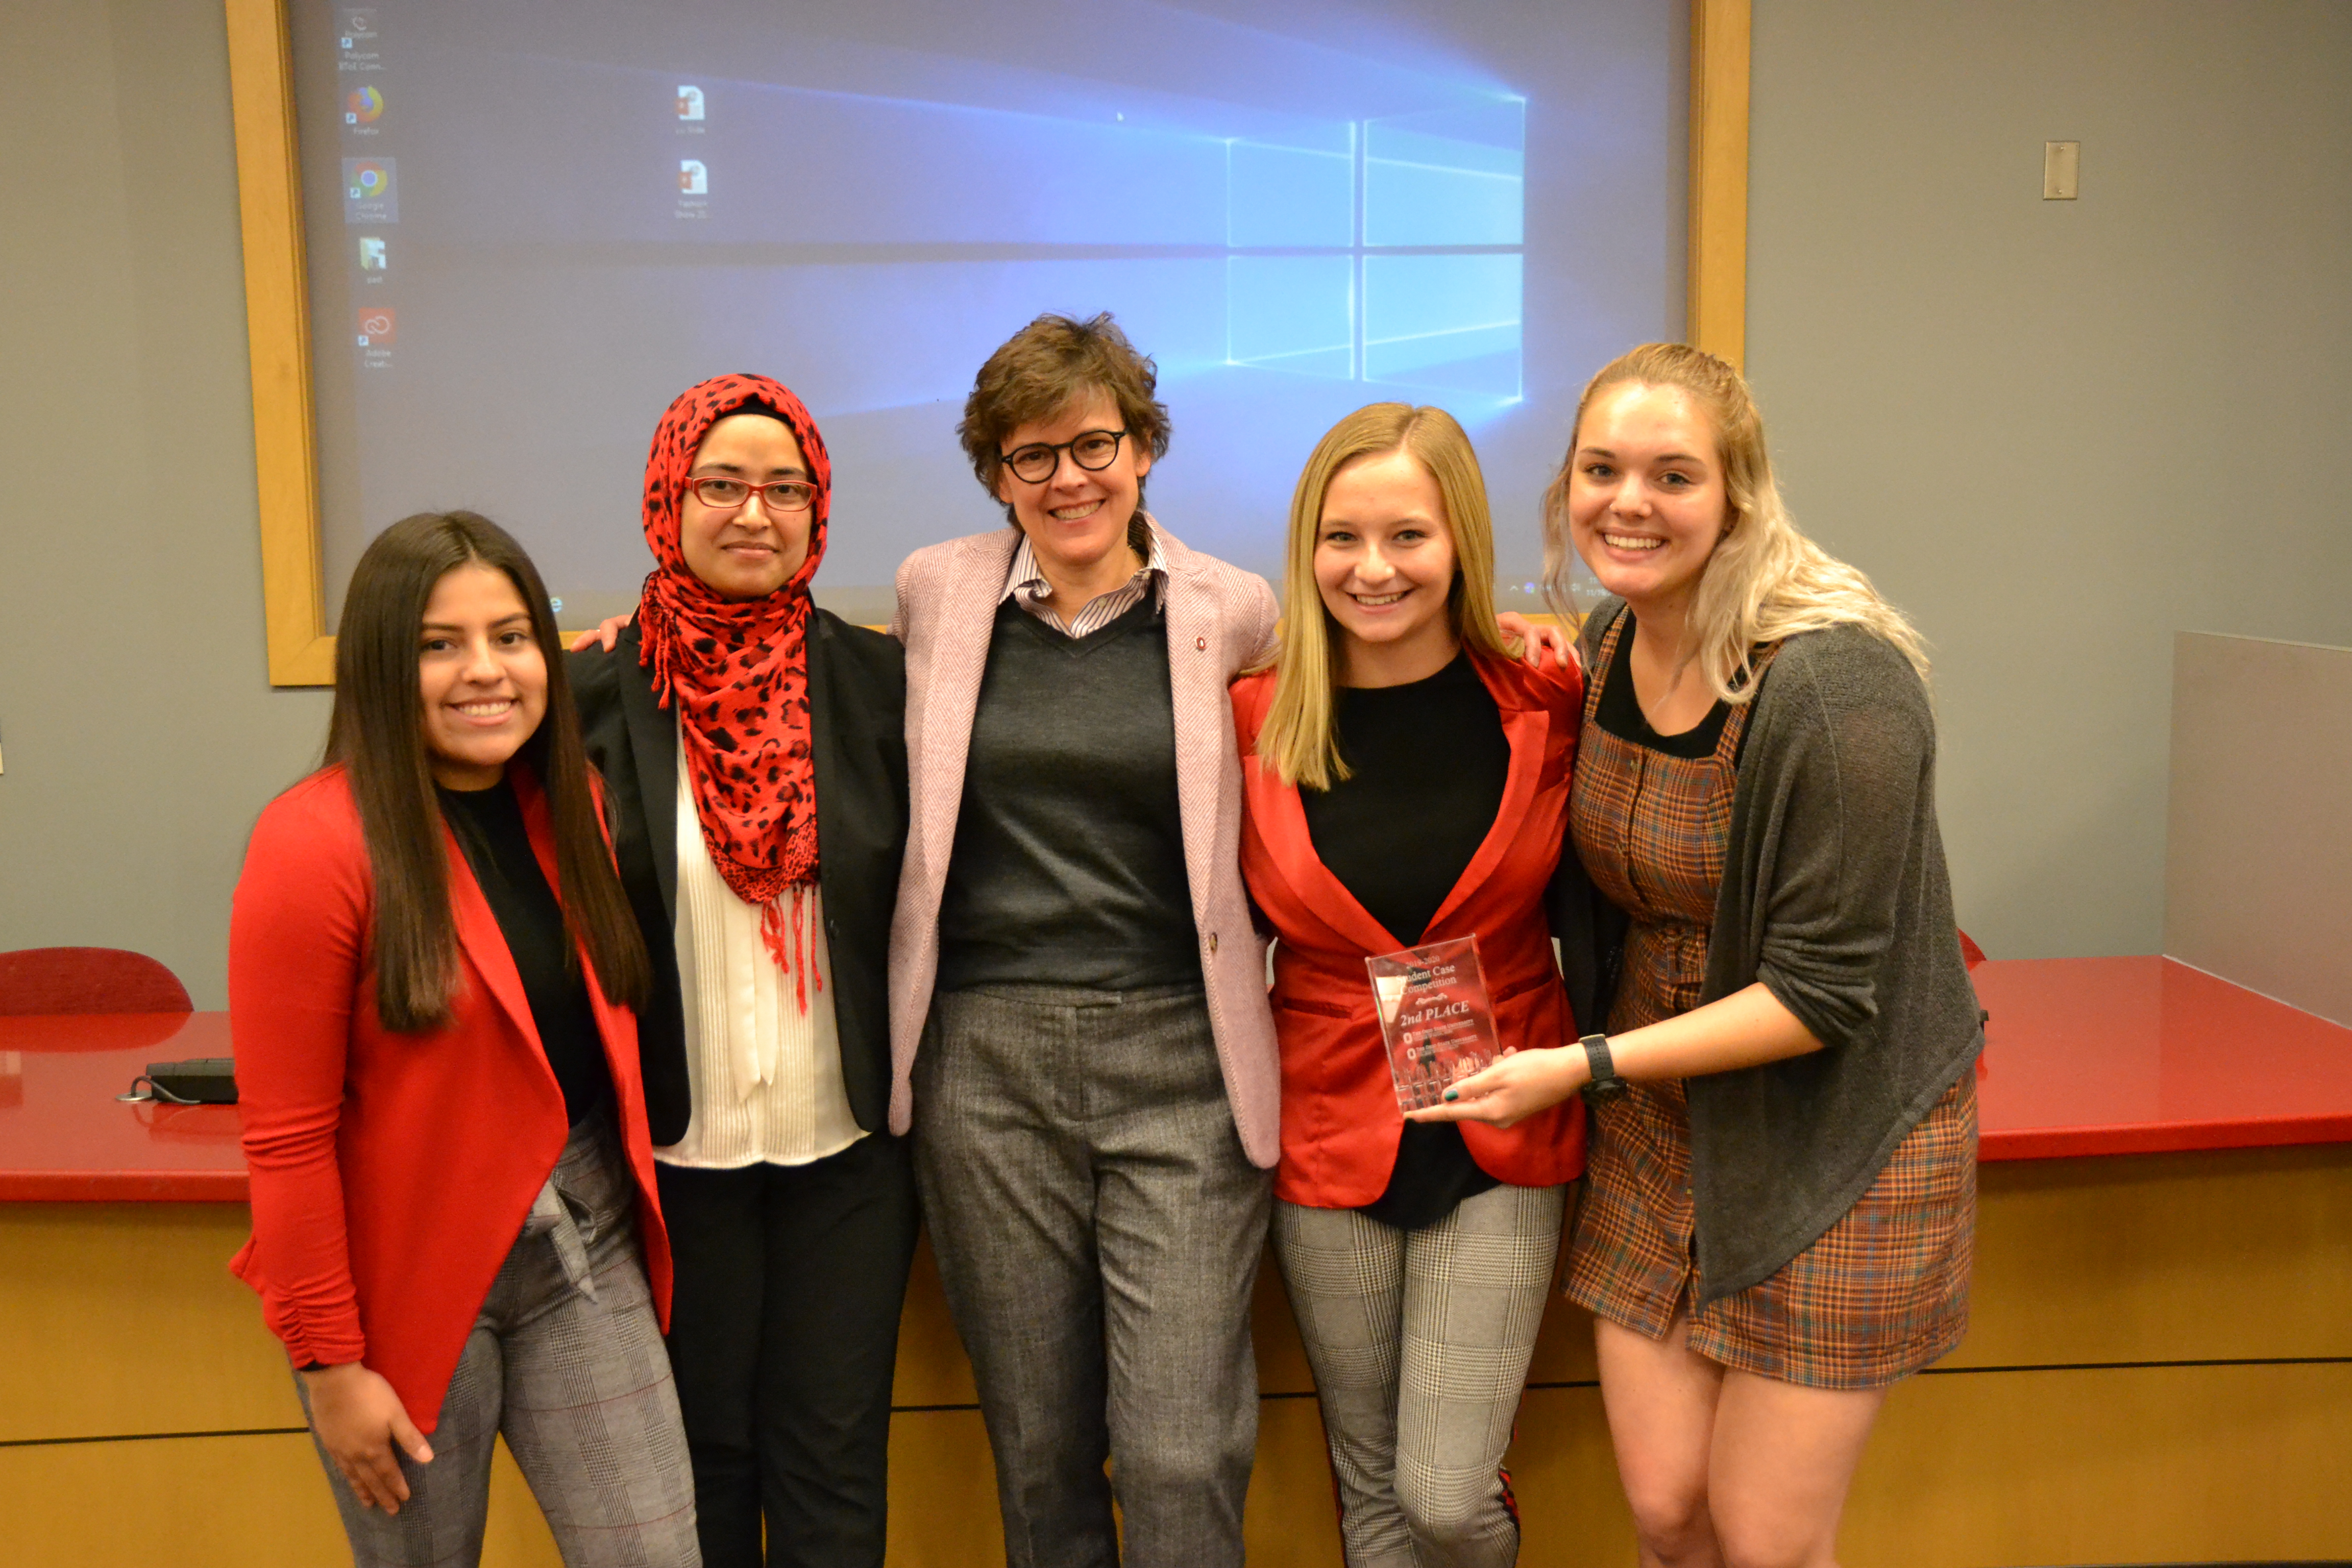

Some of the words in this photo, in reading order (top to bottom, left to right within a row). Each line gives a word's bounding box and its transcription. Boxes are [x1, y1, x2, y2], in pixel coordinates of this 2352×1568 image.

[353, 127, 379, 135] Firefox
[1406, 955, 1440, 967] 2019-2020
[1396, 970, 1431, 984] Student
[1432, 965, 1456, 976] Case
[1401, 976, 1457, 995] Competition
[1401, 1011, 1422, 1027] 2nd
[1426, 1001, 1469, 1020] PLACE
